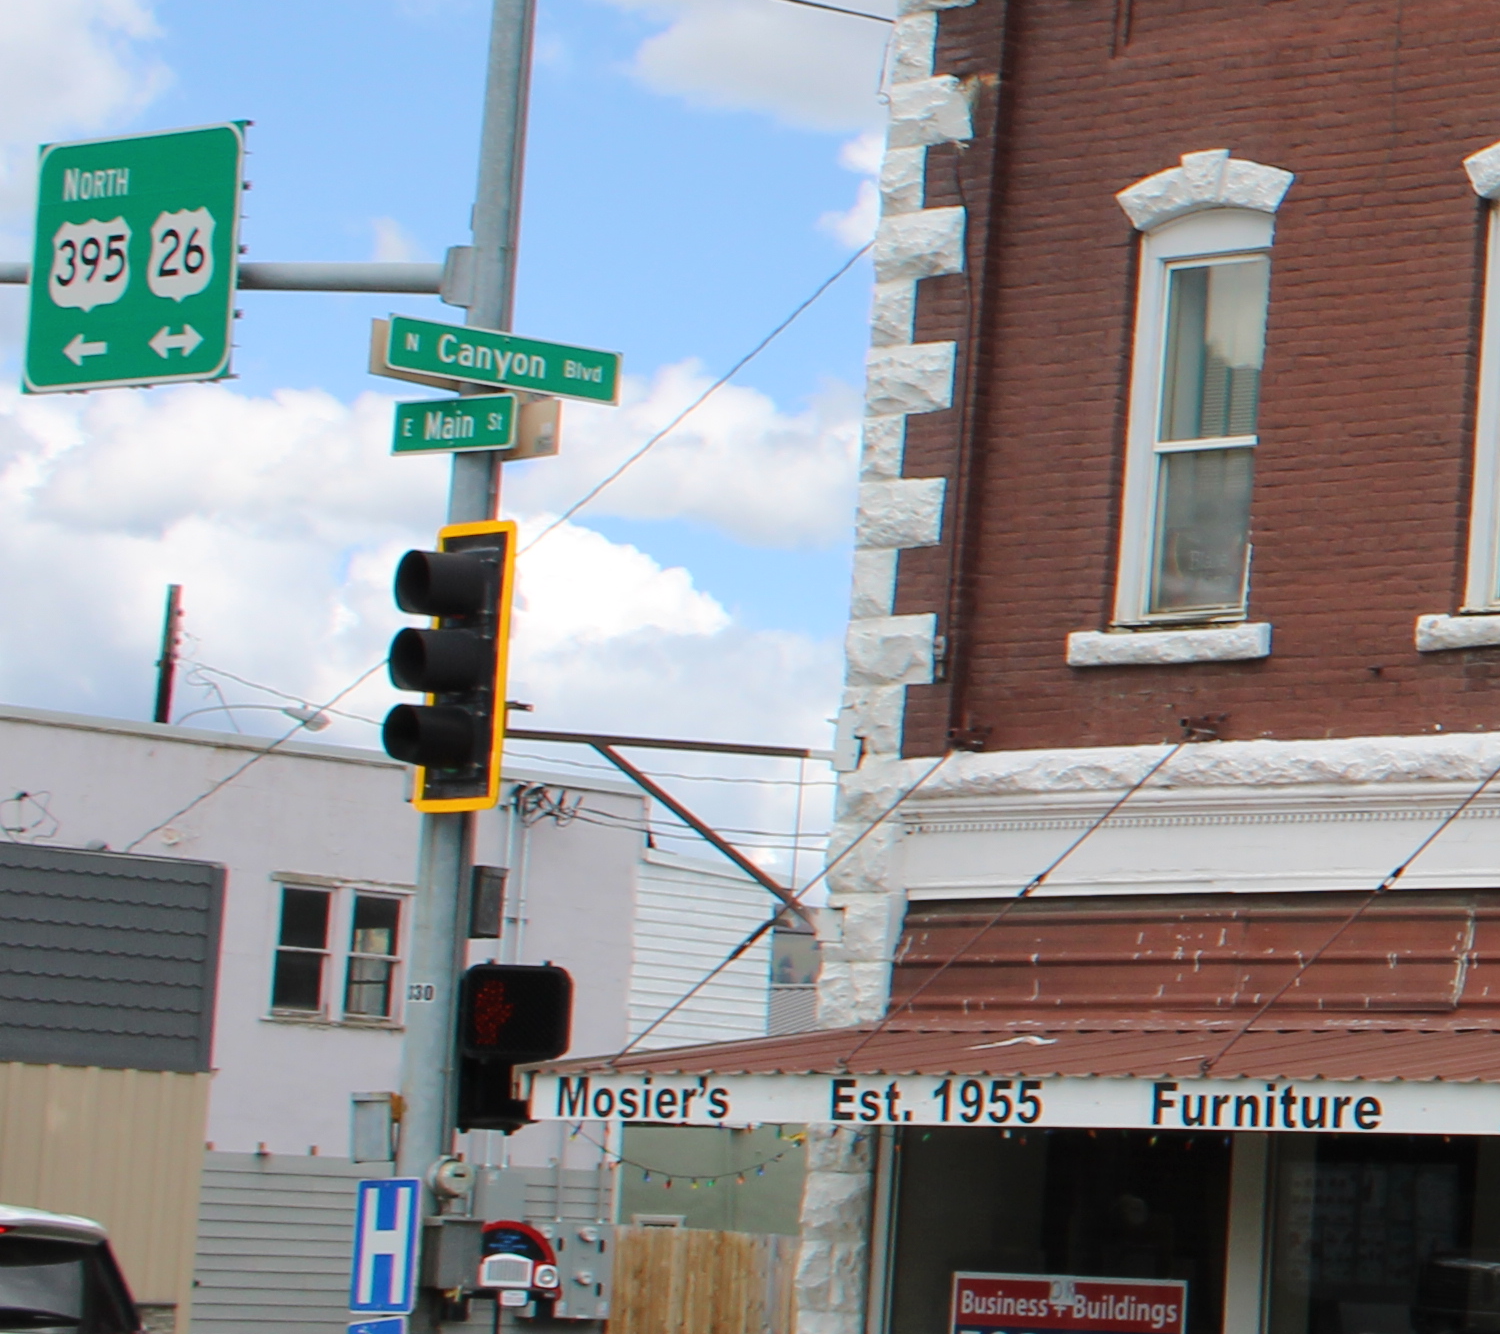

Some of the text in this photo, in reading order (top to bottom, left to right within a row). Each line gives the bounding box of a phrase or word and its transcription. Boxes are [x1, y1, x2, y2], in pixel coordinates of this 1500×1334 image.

[63, 167, 129, 201] NORTH
[56, 234, 126, 286] 395
[157, 227, 206, 277] 26
[405, 332, 603, 383] N Canyon Blvd
[403, 410, 503, 441] E Main St
[558, 1076, 730, 1118] Mosier's
[831, 1078, 913, 1122] Est.
[933, 1078, 1044, 1124] 1955
[1152, 1081, 1383, 1130] Furniture
[357, 1187, 412, 1304] H
[961, 1290, 1049, 1317] Business
[1072, 1294, 1178, 1329] Buildings
